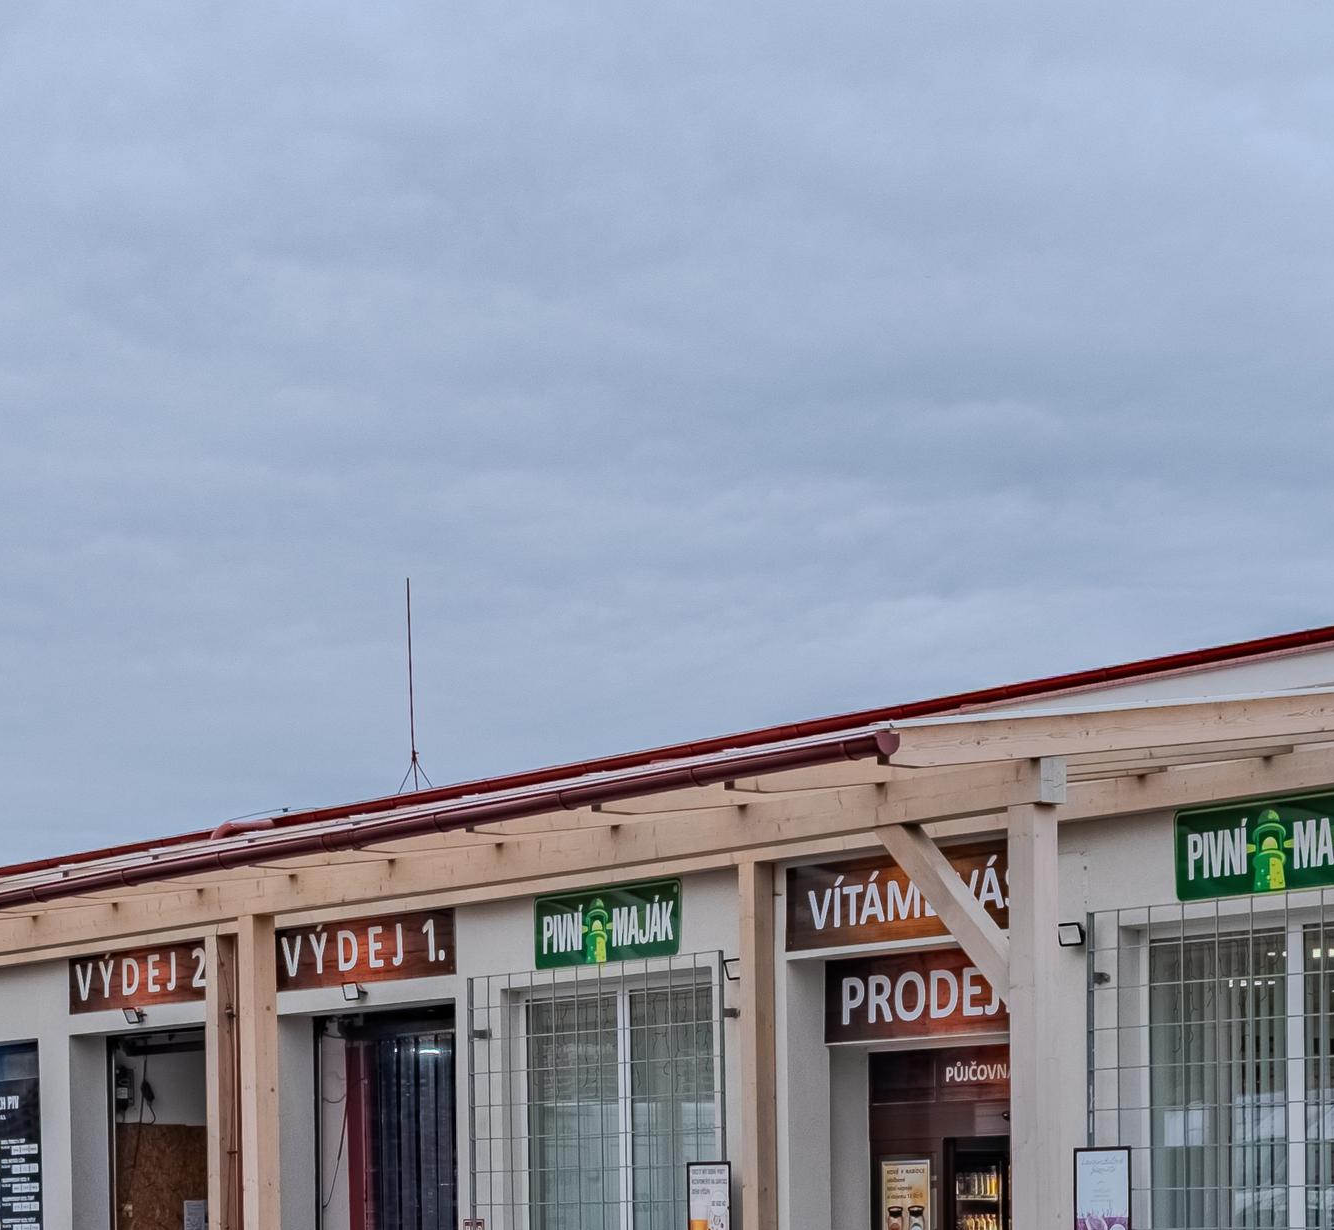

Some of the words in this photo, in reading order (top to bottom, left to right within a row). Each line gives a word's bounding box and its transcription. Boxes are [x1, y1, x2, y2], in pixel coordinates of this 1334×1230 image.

[1187, 818, 1248, 881] PIVNÍ
[280, 922, 405, 978] VÝDEJ
[421, 918, 445, 962] 1.
[543, 904, 583, 955] PIVNÍ
[612, 894, 674, 948] MAJÁK
[75, 952, 176, 1001] VÝDEJ
[842, 967, 1010, 1026] PRODEJ
[7, 1096, 19, 1109] PIV
